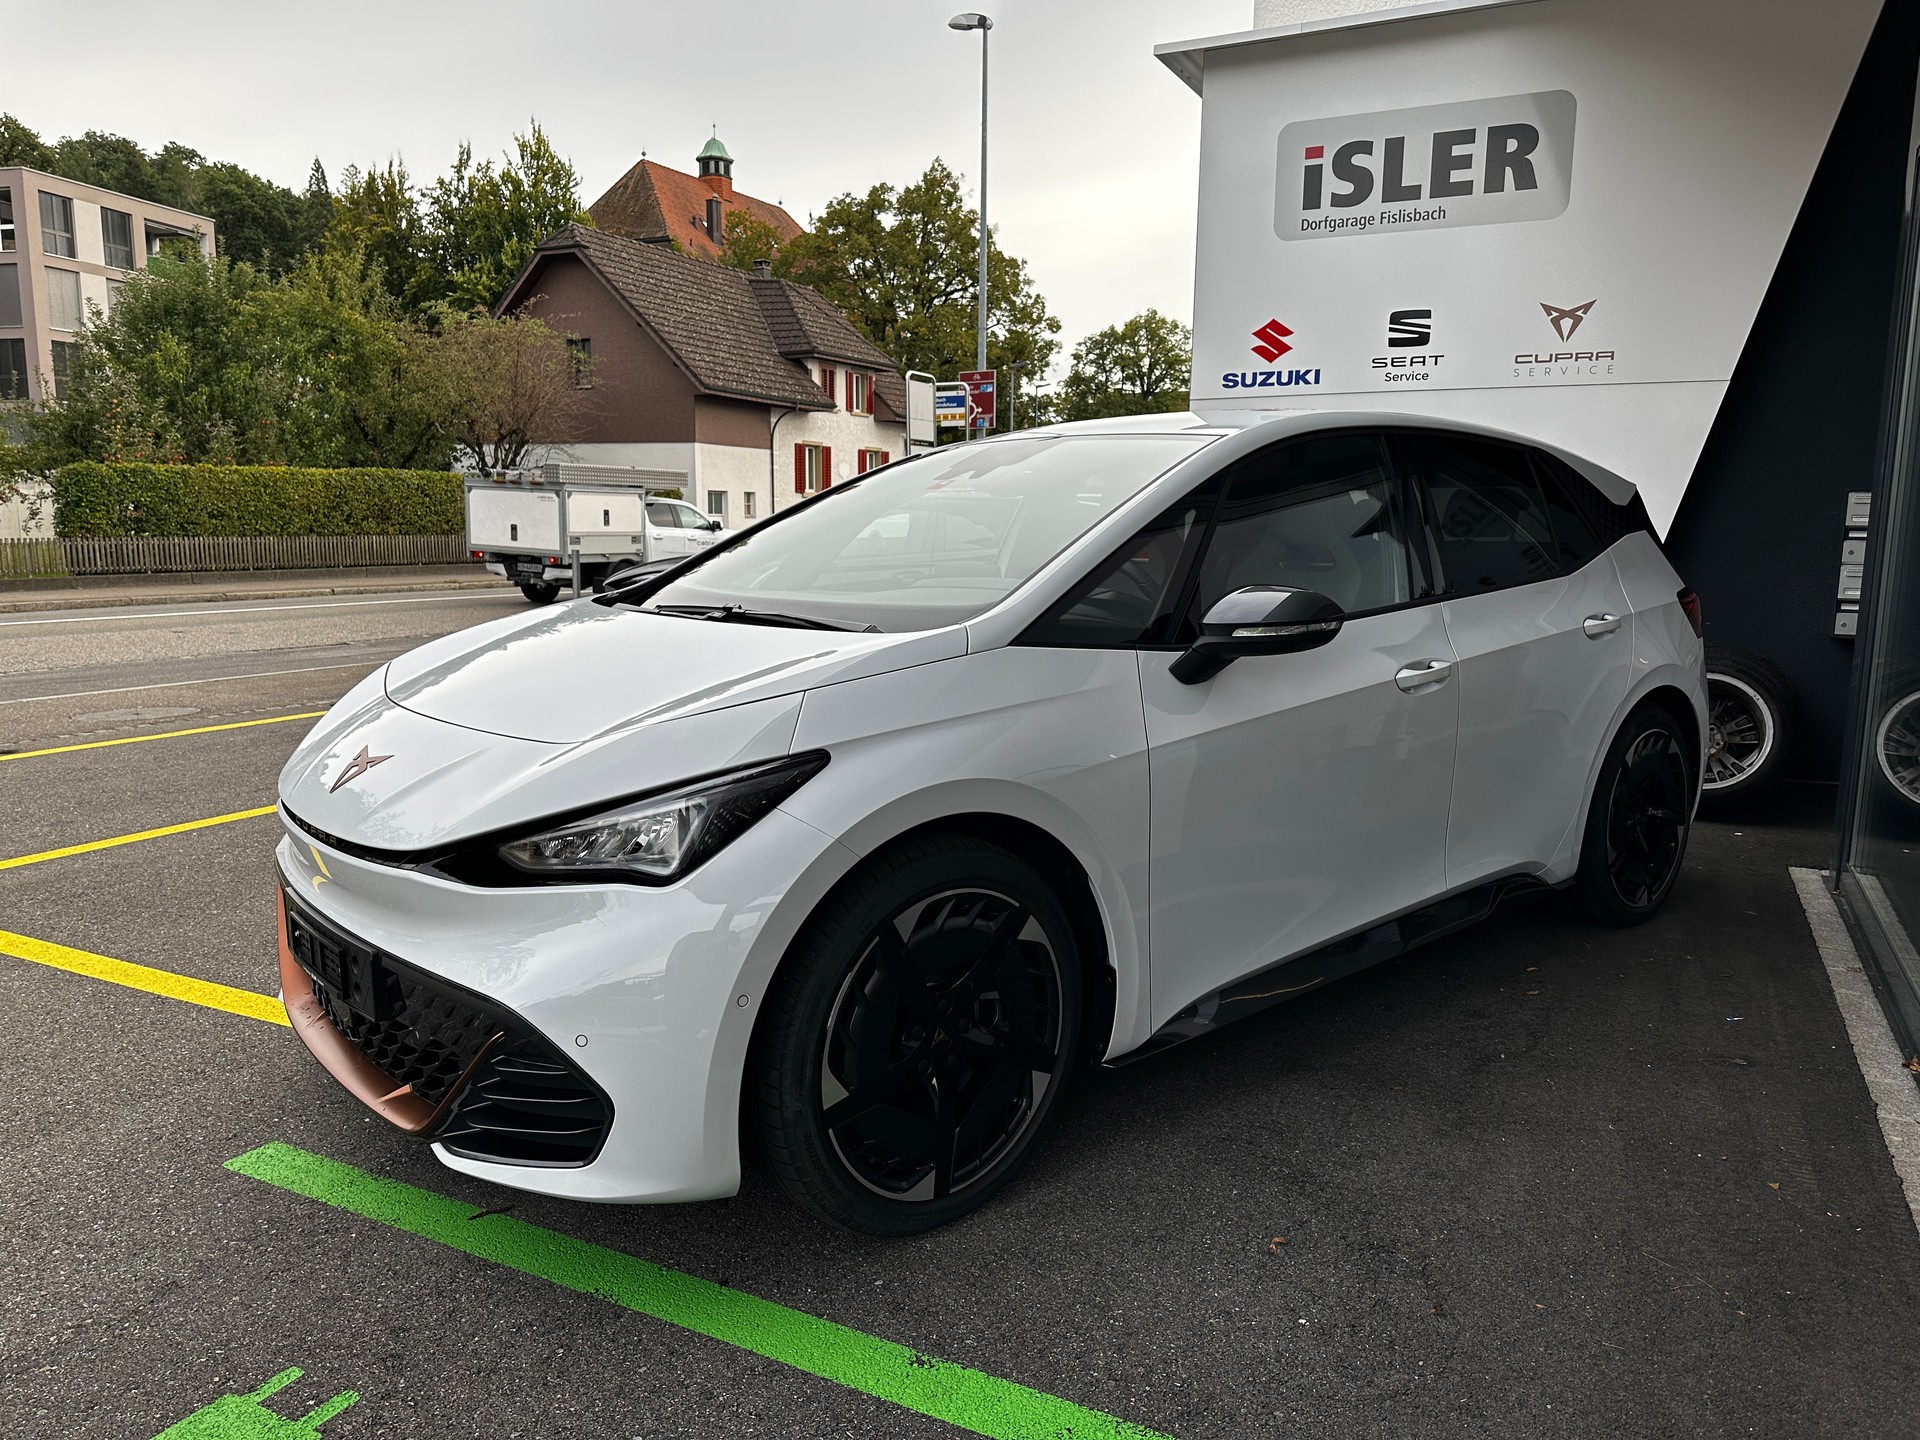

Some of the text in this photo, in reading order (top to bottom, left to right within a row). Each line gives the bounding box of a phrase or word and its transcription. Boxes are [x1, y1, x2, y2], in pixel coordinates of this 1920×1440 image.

[1300, 205, 1447, 233] Dorfgarage Fislisbach
[1370, 354, 1445, 369] SEAT
[1513, 349, 1615, 365] CUPRA
[1221, 368, 1321, 389] SUZUKI
[1383, 370, 1430, 382] Service
[1513, 364, 1615, 378] SERVICE
[295, 815, 337, 846] CUPRA
